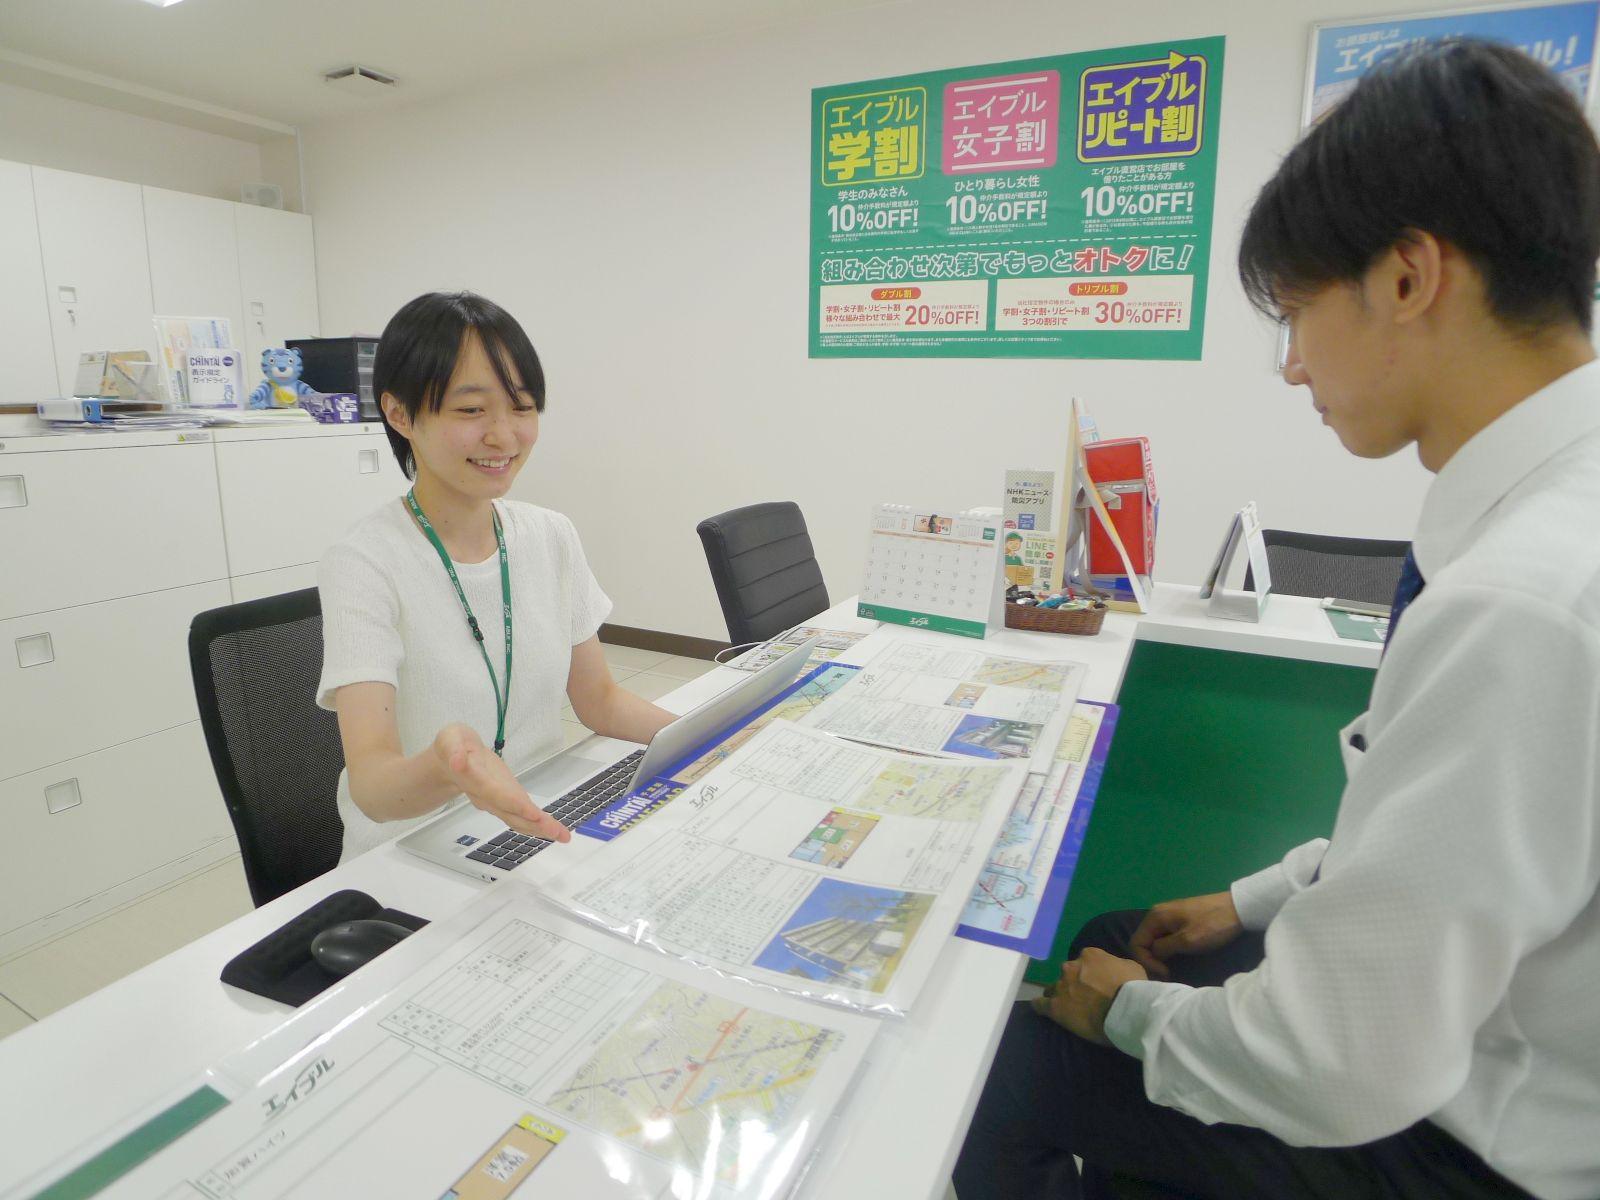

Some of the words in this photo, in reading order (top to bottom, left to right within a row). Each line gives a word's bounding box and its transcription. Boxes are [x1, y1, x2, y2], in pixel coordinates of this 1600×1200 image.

[952, 89, 1048, 120] エイブル
[1087, 71, 1197, 107] エイブル
[830, 95, 919, 128] エイブル
[1085, 103, 1195, 149] リピート割
[827, 124, 919, 181] 学割
[952, 118, 1047, 158] 女子割
[837, 185, 908, 202] 学生のみなさん
[954, 174, 1040, 192] ひとり暮らし女性
[945, 194, 1047, 225] 10%OFF!
[1081, 185, 1194, 217] 10%OFF!
[827, 203, 919, 233] 10%OFF!
[820, 244, 1195, 283] 組み合わせ次第でもっとオトクに!
[880, 290, 912, 299] ダブル割
[904, 304, 979, 326] 20%OFF!
[1022, 317, 1068, 326] 3つの割引で
[1094, 300, 1182, 324] 30%OFF!
[600, 795, 653, 829] CHINTAI
